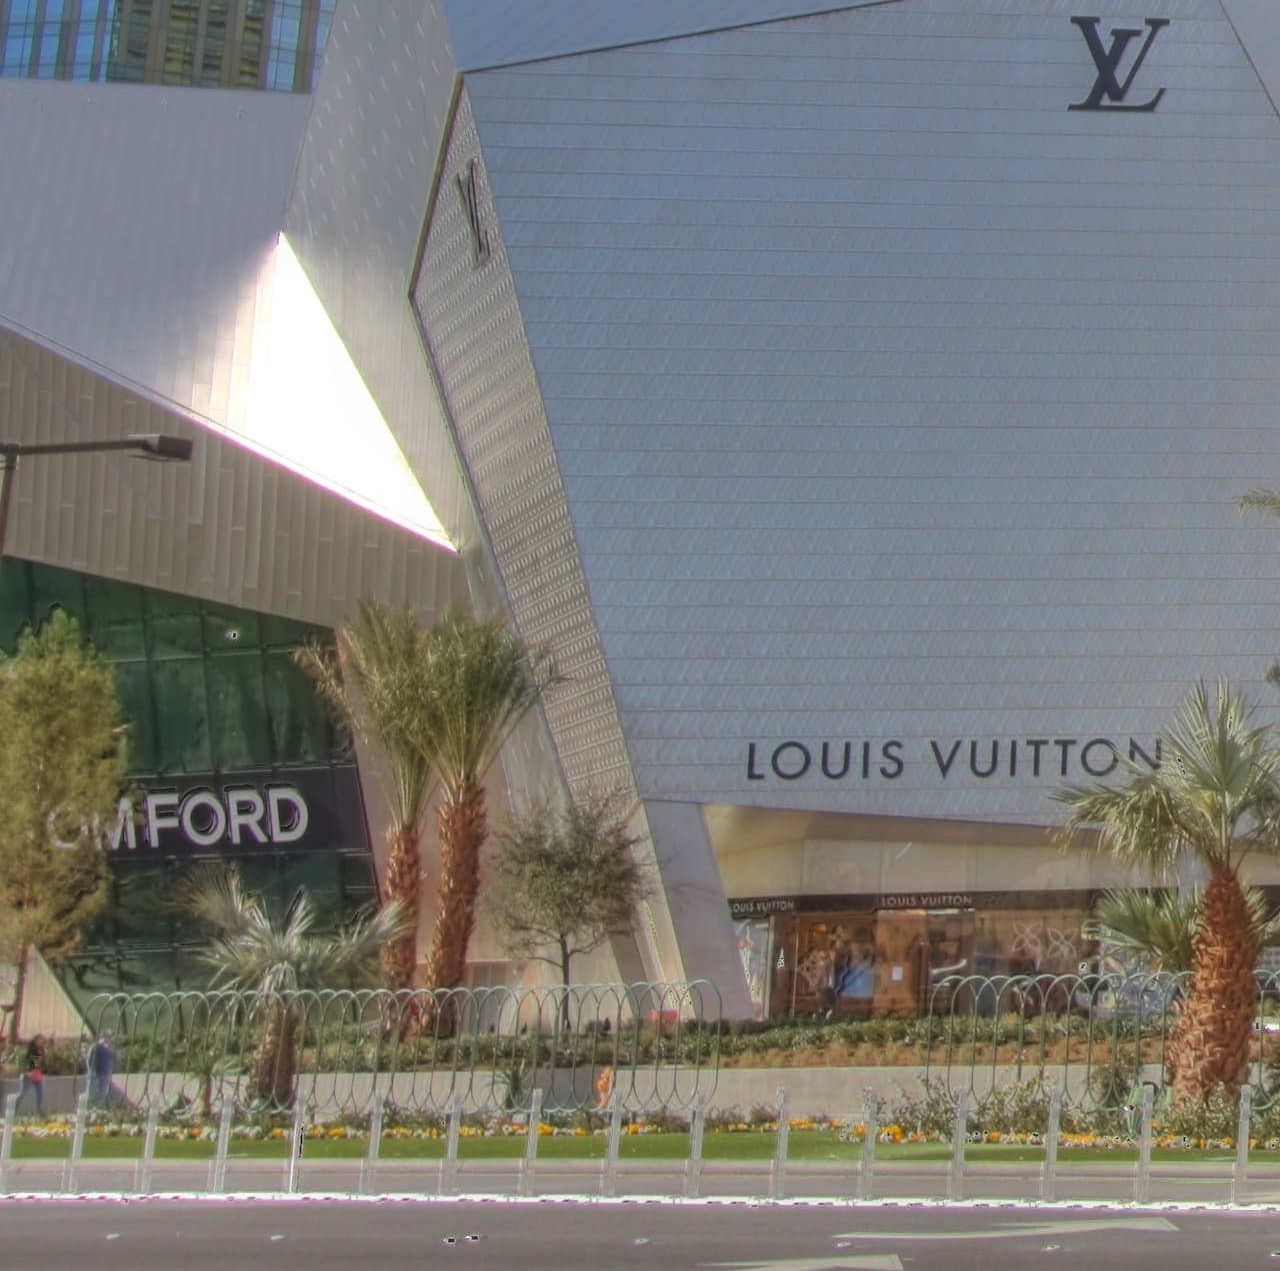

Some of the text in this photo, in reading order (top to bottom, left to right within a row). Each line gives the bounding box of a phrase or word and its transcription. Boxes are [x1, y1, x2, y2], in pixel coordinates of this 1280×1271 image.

[1067, 16, 1170, 113] LV
[747, 737, 1162, 779] LOUIS VUITTON
[25, 786, 309, 850] OM FORD
[756, 899, 796, 913] VUITTON
[881, 894, 973, 907] LOUIS VUITTON
